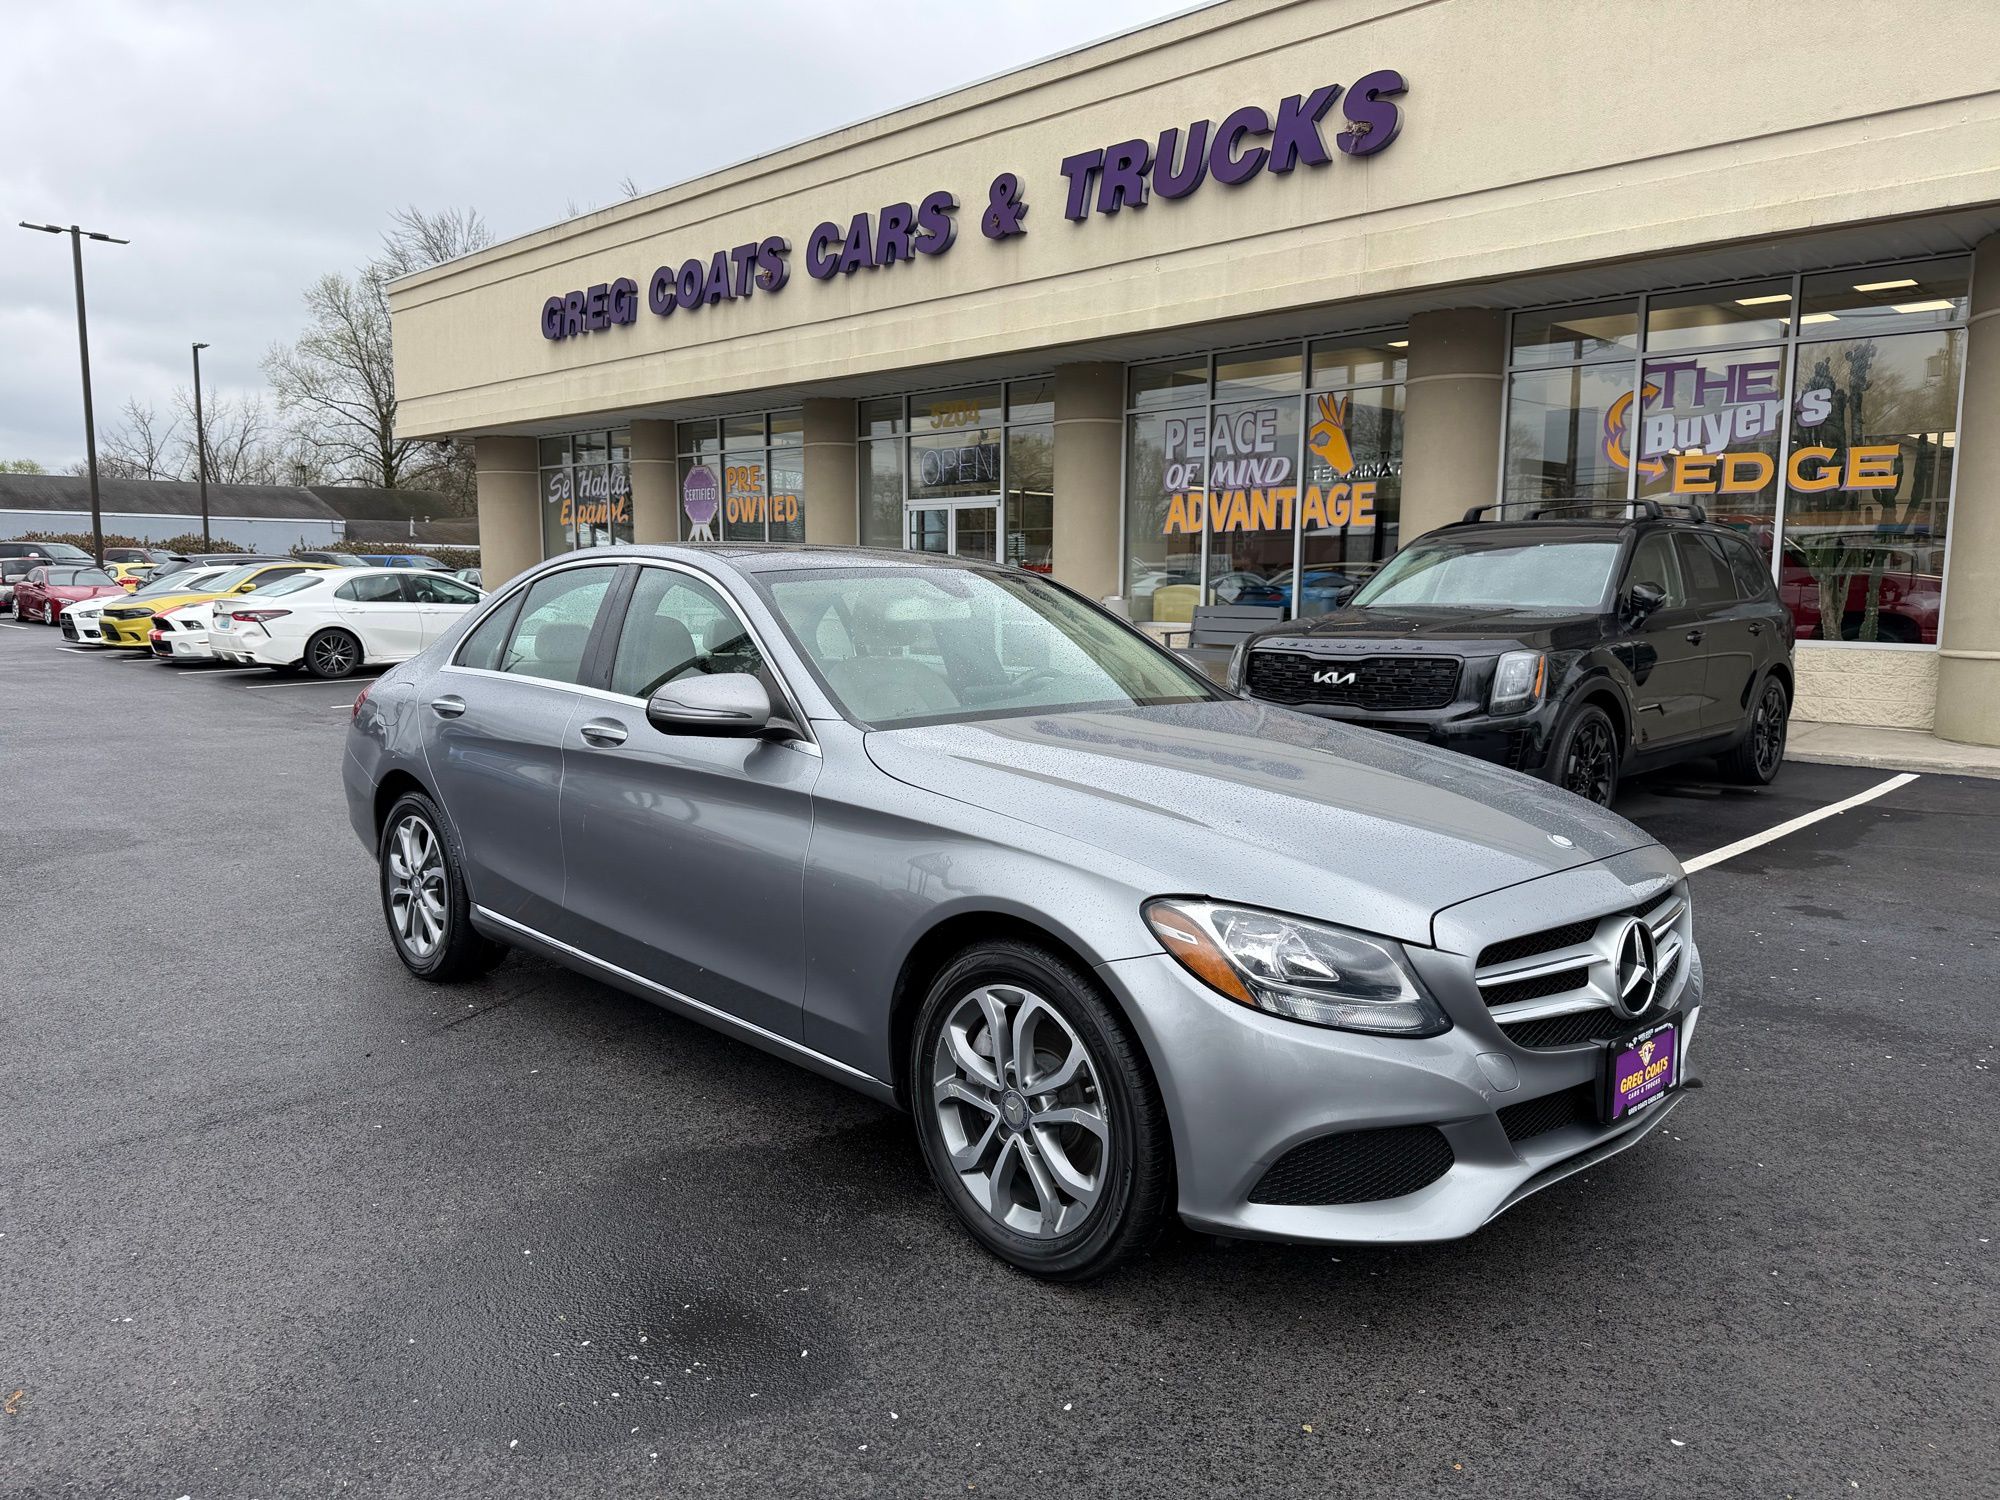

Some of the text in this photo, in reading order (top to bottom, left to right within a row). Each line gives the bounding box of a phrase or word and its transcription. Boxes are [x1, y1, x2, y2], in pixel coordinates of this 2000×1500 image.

[541, 69, 1409, 341] GREG COATS CARS & TRUCKS
[1643, 359, 1780, 411] THE
[930, 400, 980, 429] 5204
[1164, 408, 1277, 460] PEACE
[921, 443, 994, 485] OPEN
[1164, 456, 1292, 492] OF MIND
[1671, 444, 1900, 494] EDGE
[548, 467, 630, 504] Se Habla
[684, 487, 717, 502] CERTIFIED
[726, 495, 799, 524] OWNED
[1163, 481, 1377, 535] ADVANTAGE
[1620, 1056, 1669, 1094] GREG COATS
